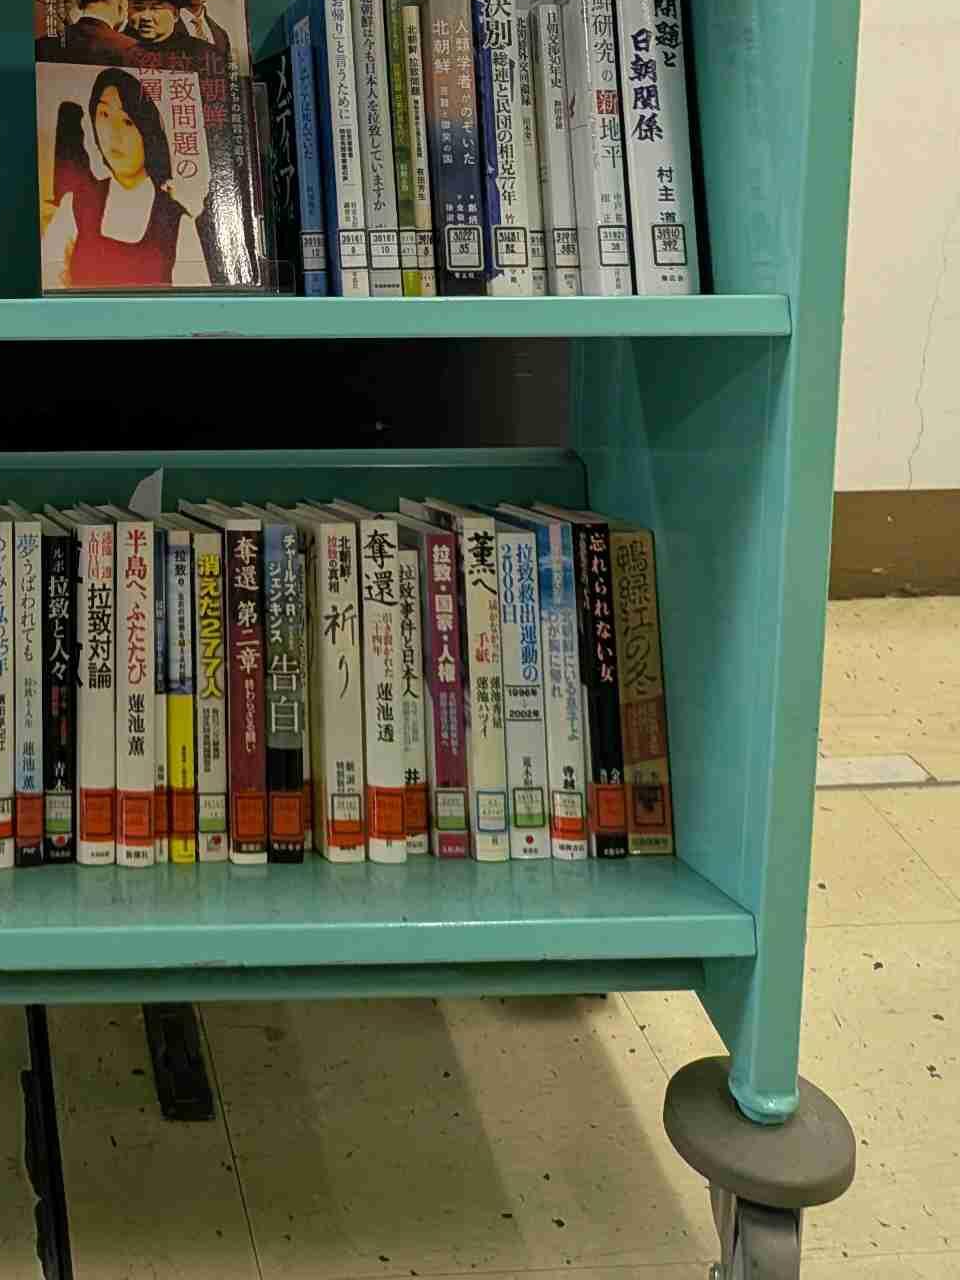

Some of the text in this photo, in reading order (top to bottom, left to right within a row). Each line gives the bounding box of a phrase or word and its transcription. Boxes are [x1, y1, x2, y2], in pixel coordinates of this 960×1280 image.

[431, 18, 452, 76] 北朝鮮
[629, 28, 664, 143] 日朝関係
[655, 166, 677, 202] 村主
[16, 533, 39, 662] 夢うばわれても
[125, 528, 147, 685] 半島へ、ふたたび
[232, 536, 262, 675] 奪還 第二章
[270, 561, 283, 644] ジェンキンス
[363, 529, 398, 607] 奪還
[431, 543, 456, 683] 拉致・国家・人権
[468, 530, 498, 595] 薫へ
[516, 544, 538, 682] 拉致救出運動の
[589, 531, 616, 684] 忘れられない女
[48, 575, 71, 681] 拉致と人々
[87, 583, 112, 690] 拉致対論
[198, 553, 223, 699] 消えた277人
[324, 603, 357, 700] 祈り
[399, 564, 421, 699] 拉致事件と日本人
[127, 693, 146, 756] 蓮池薫
[269, 653, 300, 735] 告白
[376, 681, 394, 743] 蓮池透
